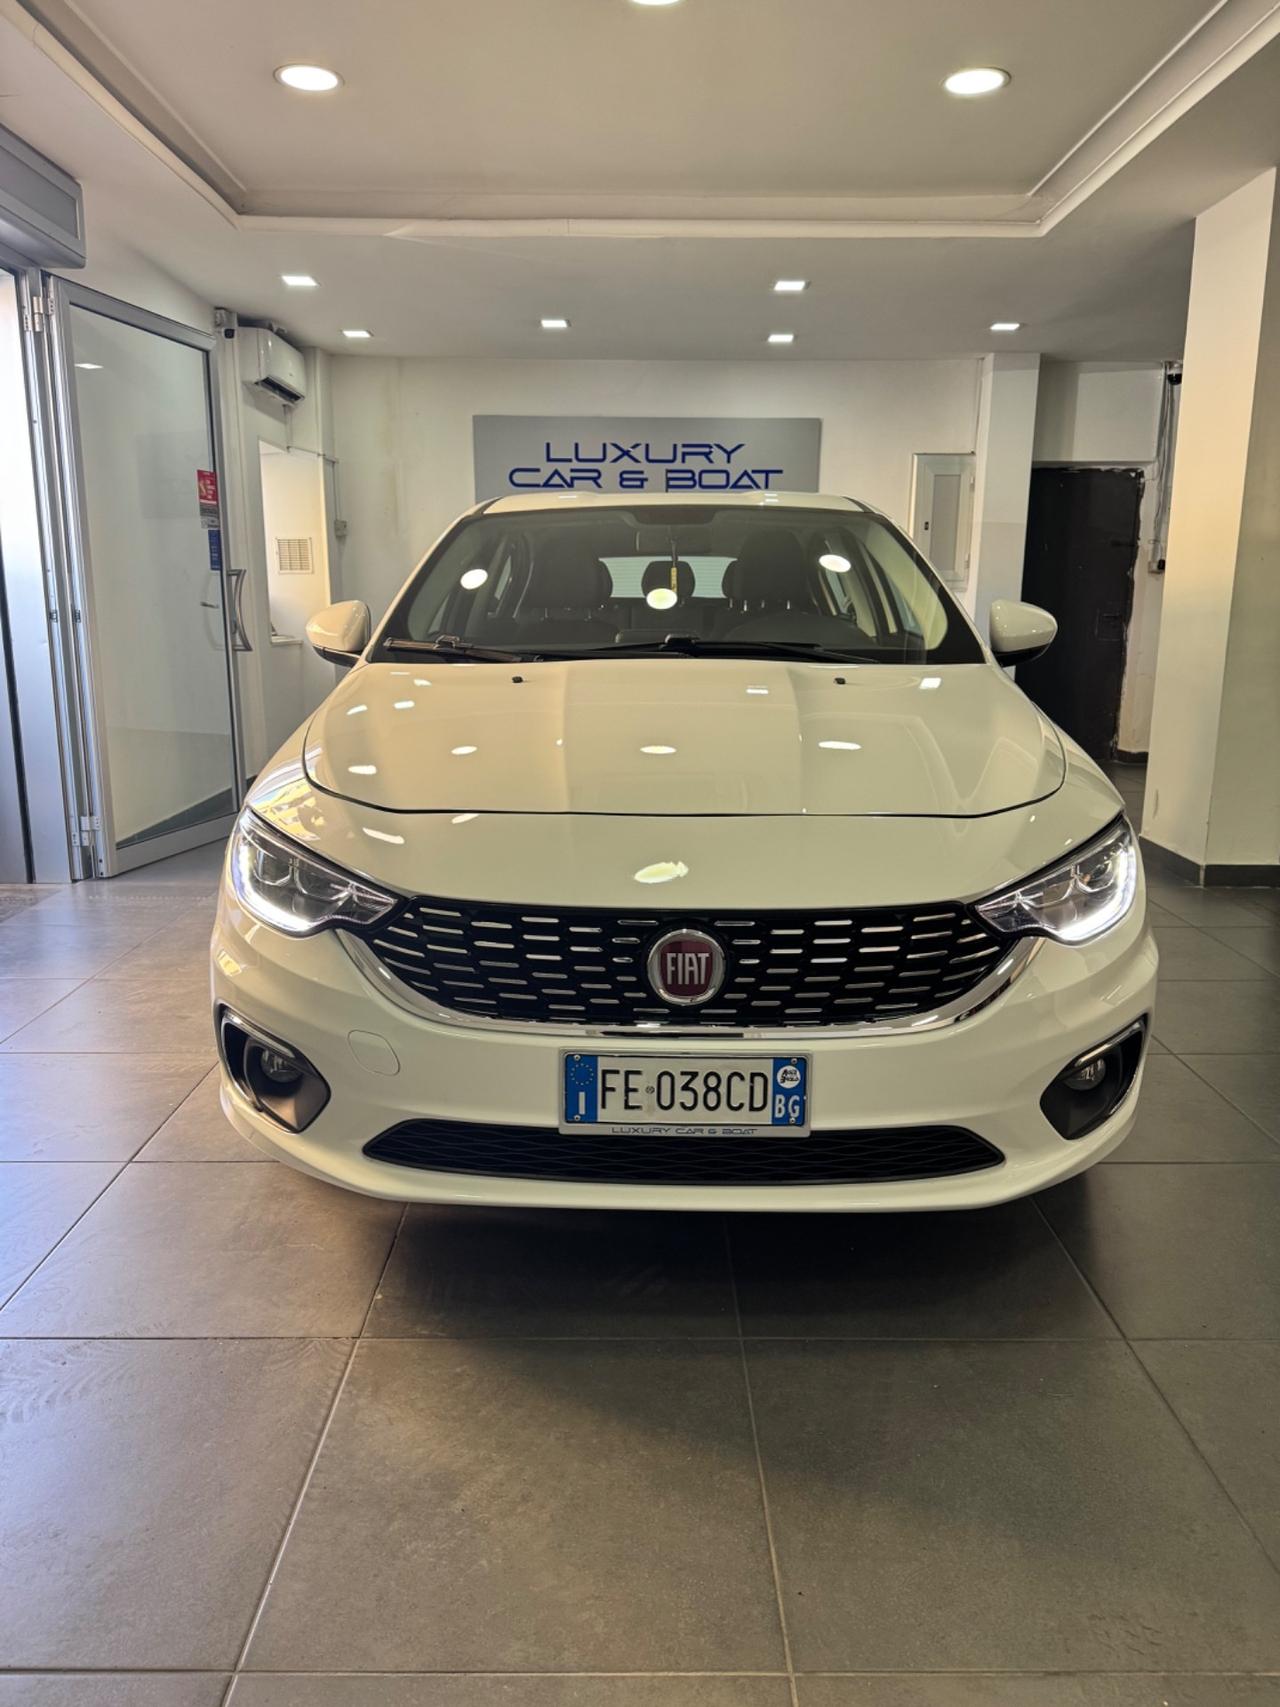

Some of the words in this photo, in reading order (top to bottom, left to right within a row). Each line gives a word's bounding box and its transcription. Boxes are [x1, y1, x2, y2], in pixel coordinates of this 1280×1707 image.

[545, 442, 745, 464] LUXURY
[508, 468, 603, 489] CAR
[618, 470, 649, 489] &
[665, 469, 783, 490] BOAT
[666, 952, 710, 985] FIAT
[600, 1069, 643, 1110] FE
[656, 1070, 769, 1112] 038CD
[775, 1094, 801, 1118] BG
[611, 1126, 671, 1134] LUXURY
[675, 1127, 704, 1135] CAR
[721, 1128, 758, 1136] BOAT
